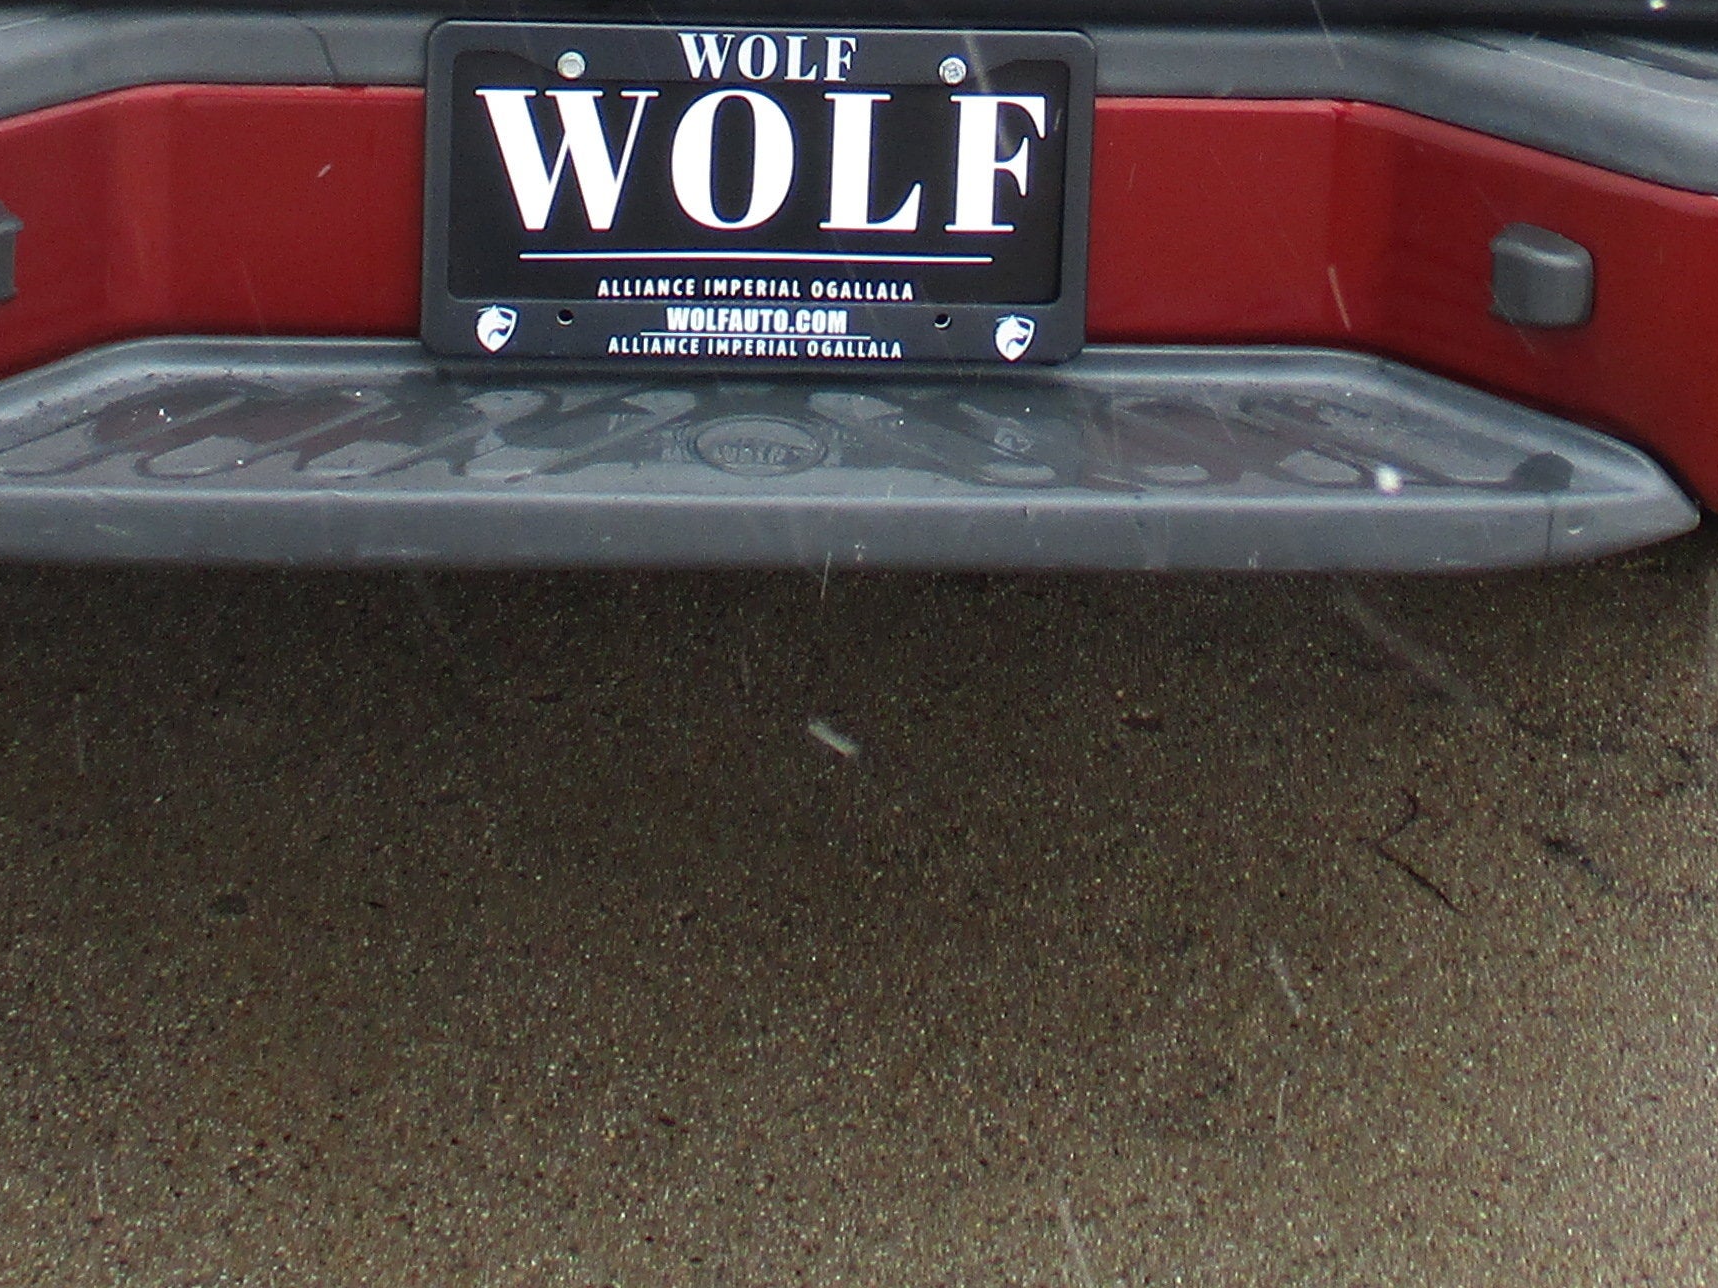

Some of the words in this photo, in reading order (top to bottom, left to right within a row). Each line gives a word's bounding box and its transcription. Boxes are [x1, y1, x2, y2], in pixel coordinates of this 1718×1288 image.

[677, 32, 858, 83] WOLF
[474, 87, 1047, 232] WOLF
[596, 277, 696, 299] ALLIANCE
[703, 278, 802, 299] IMPERIAL
[810, 280, 915, 301] OGALLALA
[665, 306, 849, 335] WOLFAUTO.COM
[607, 336, 700, 355] ALLIANCE
[706, 337, 799, 358] IMPERIAL
[806, 339, 903, 360] OGALLALA
